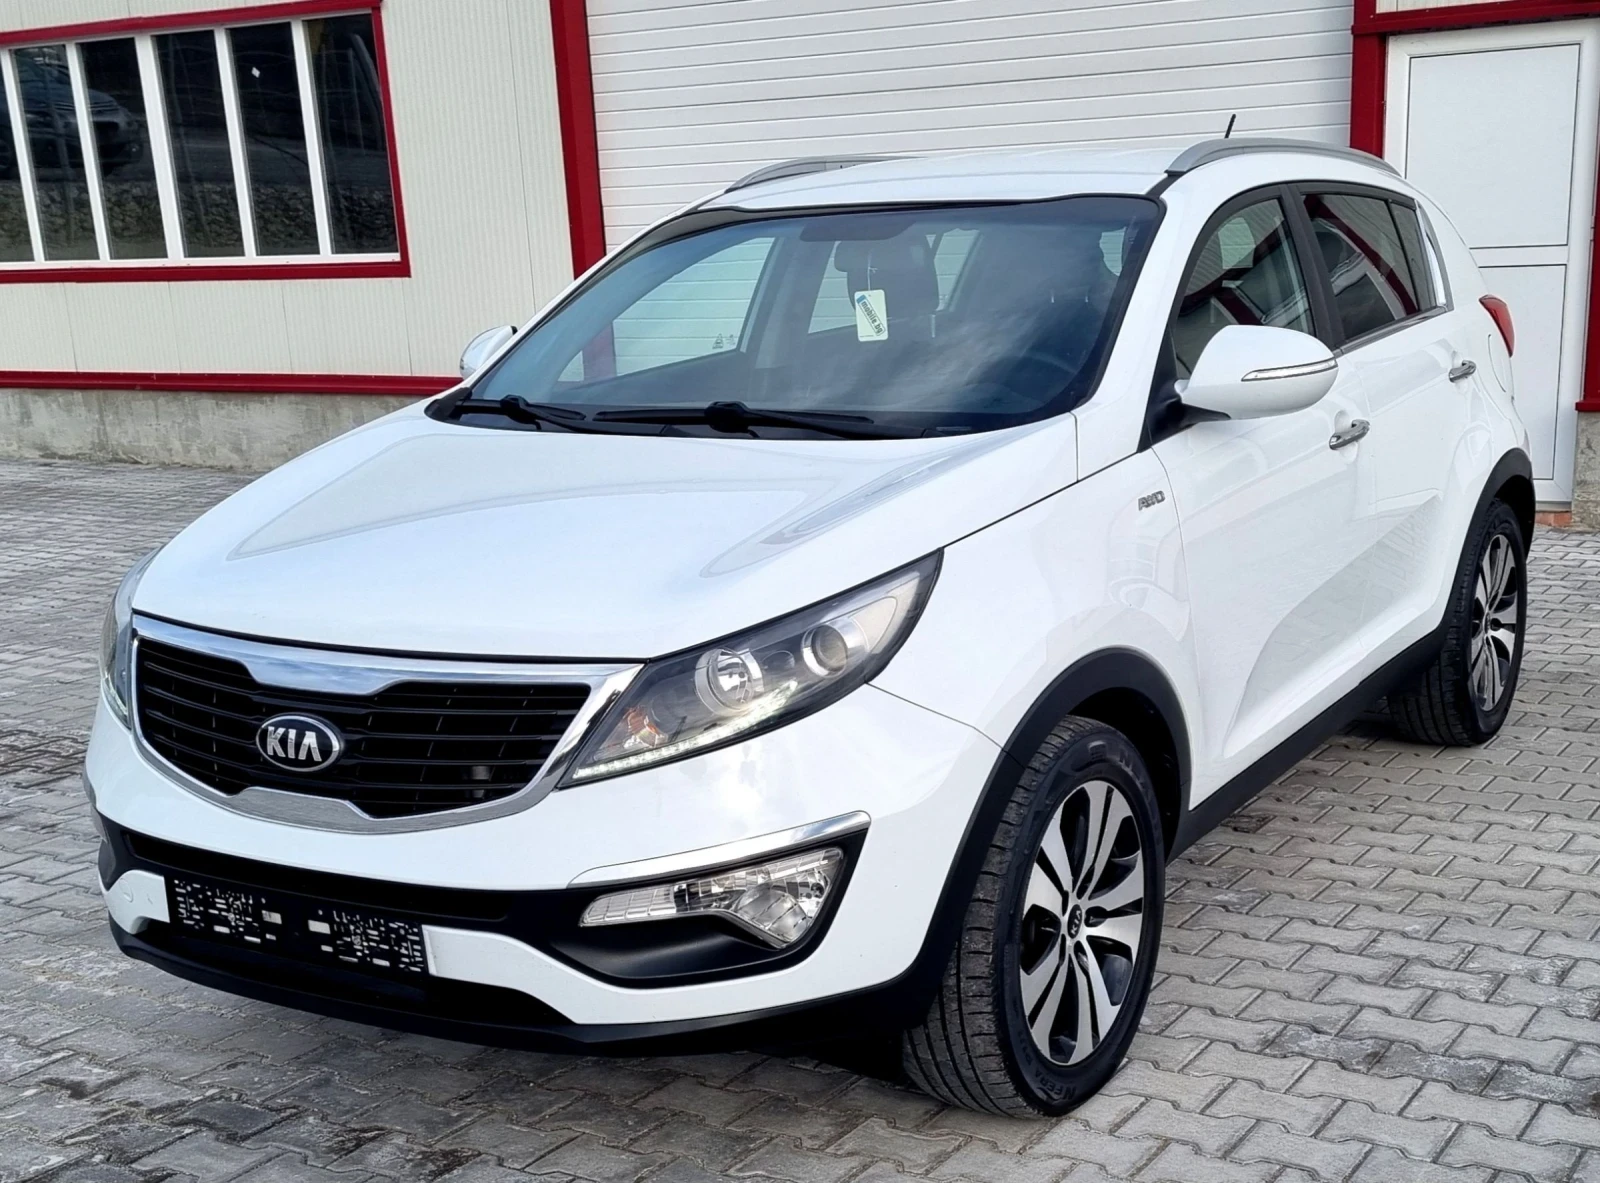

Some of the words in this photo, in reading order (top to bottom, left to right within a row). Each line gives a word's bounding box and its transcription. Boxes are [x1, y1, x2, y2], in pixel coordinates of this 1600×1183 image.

[860, 300, 884, 334] mobile.bg
[1137, 490, 1166, 511] AWD
[266, 725, 323, 762] KIA
[1070, 910, 1081, 935] KIA
